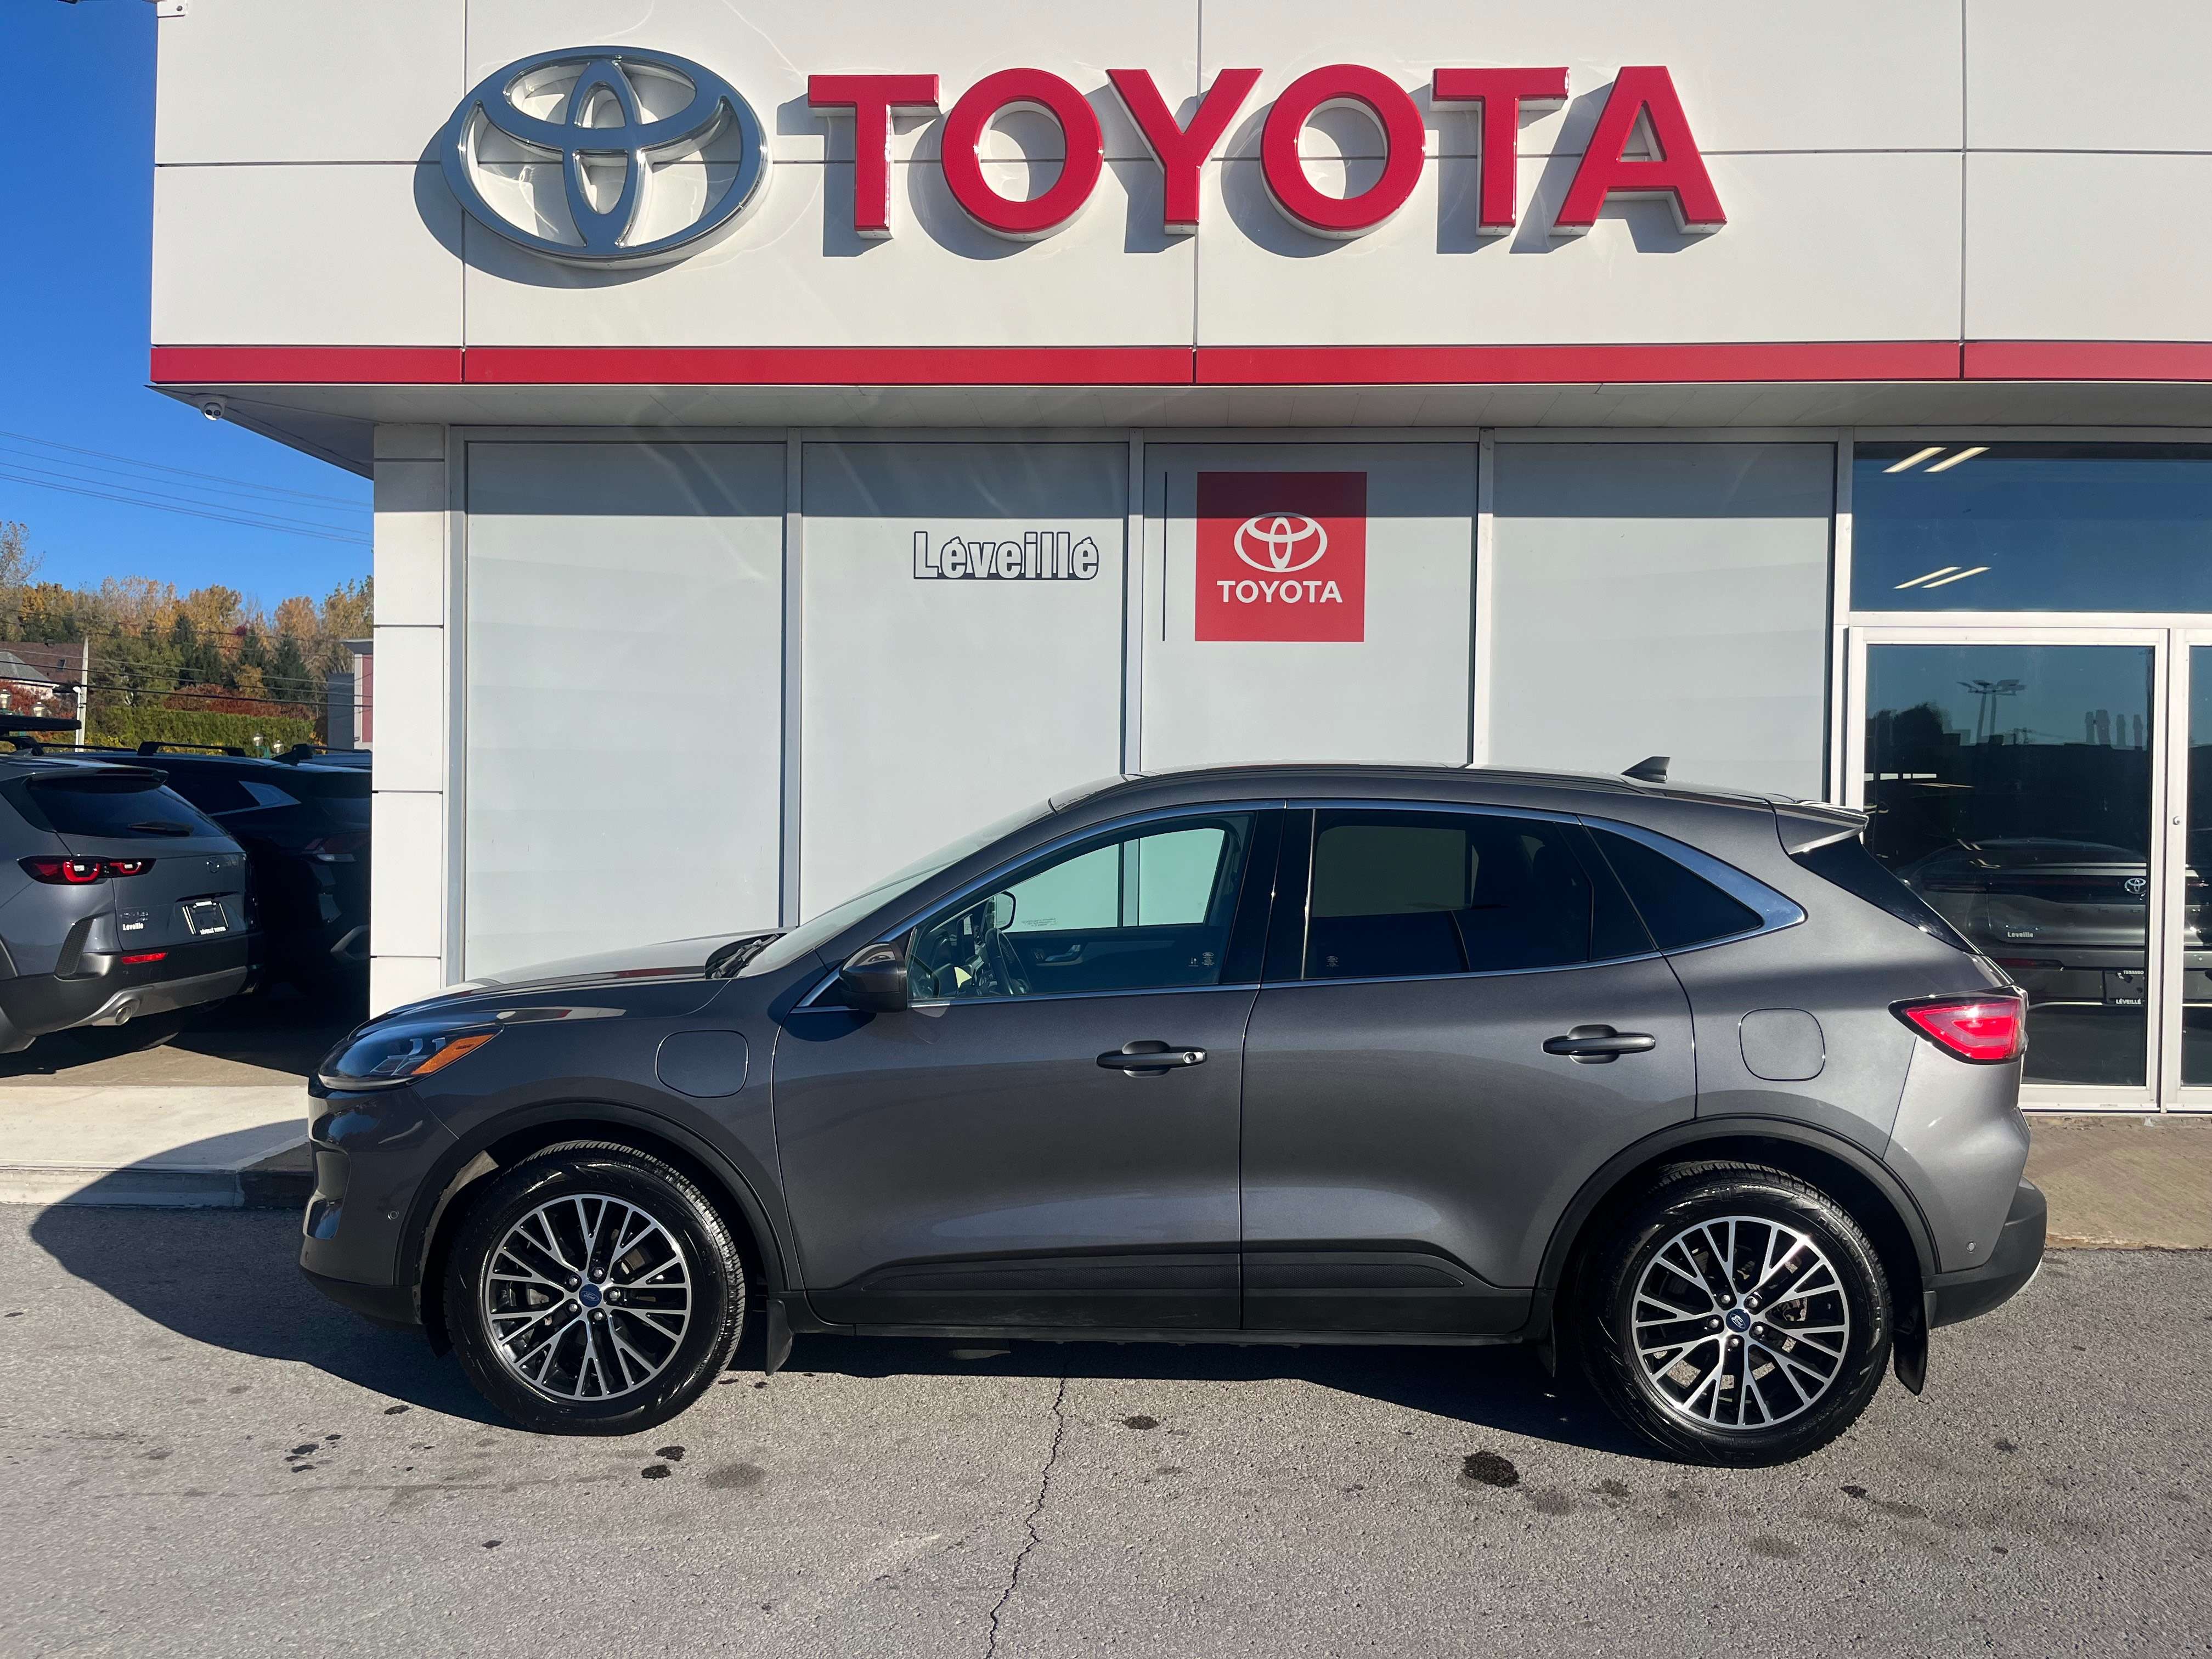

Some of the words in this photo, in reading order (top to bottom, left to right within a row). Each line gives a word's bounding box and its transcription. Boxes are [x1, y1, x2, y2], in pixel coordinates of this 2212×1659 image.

[808, 64, 1728, 240] TOYOTA
[913, 531, 1099, 580] Léveillé
[1216, 580, 1344, 604] TOYOTA
